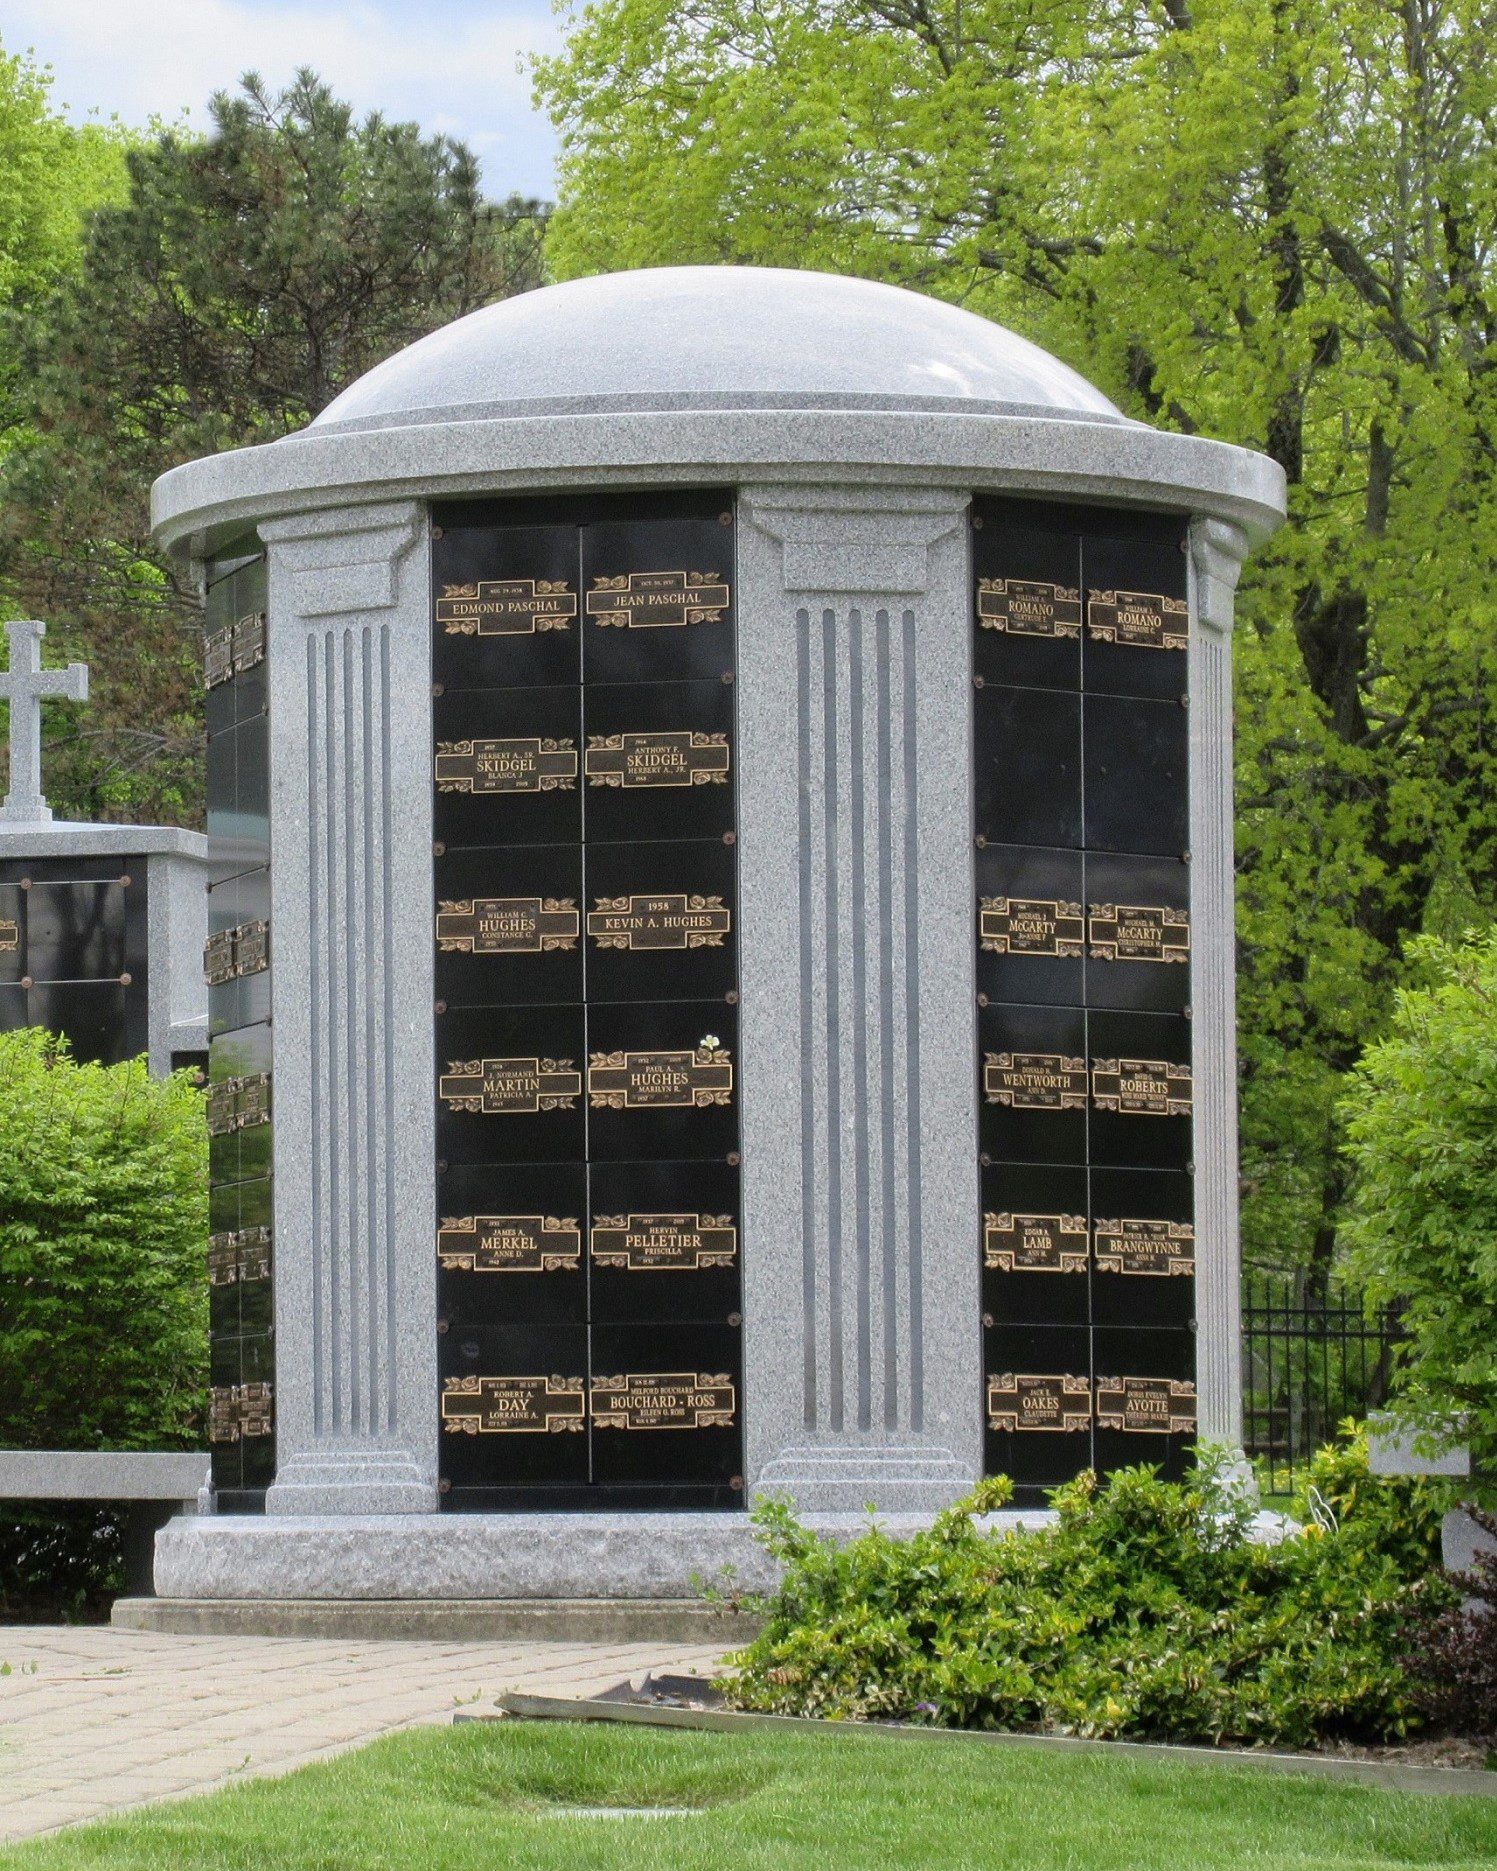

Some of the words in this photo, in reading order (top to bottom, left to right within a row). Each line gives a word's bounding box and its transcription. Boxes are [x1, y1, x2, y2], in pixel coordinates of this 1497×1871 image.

[614, 596, 644, 606] JEAN
[649, 593, 701, 605] PASCHAL
[453, 603, 504, 614] EDMOND
[508, 601, 560, 612] PASCHAL
[1009, 600, 1053, 616] ROMANO
[1118, 612, 1161, 627] ROMANO
[477, 759, 536, 772] SKIDGEL
[628, 754, 687, 767] SKIDGEL
[649, 902, 669, 910] 1958
[480, 919, 536, 932] HUGHES
[605, 918, 643, 929] KEVIN
[647, 918, 659, 928] A.
[664, 916, 712, 927] HUGHES
[1009, 920, 1056, 933] McCARTY
[1117, 926, 1163, 940] McCARTY
[483, 1079, 540, 1092] MARTIN
[631, 1073, 688, 1085] HUGHES
[1003, 1073, 1070, 1088] WENTWORTH
[1120, 1080, 1168, 1094] ROBERTS
[481, 1237, 537, 1249] MERKEL
[626, 1234, 702, 1247] PELLETIER
[1023, 1236, 1052, 1248] LAMB
[1110, 1240, 1181, 1254] BRANGWYNNE
[499, 1399, 529, 1411] DAY
[610, 1396, 676, 1408] BOUCHARD
[687, 1395, 716, 1407] ROSS
[1023, 1397, 1059, 1409] OAKES
[1126, 1400, 1168, 1412] AYOTTE
